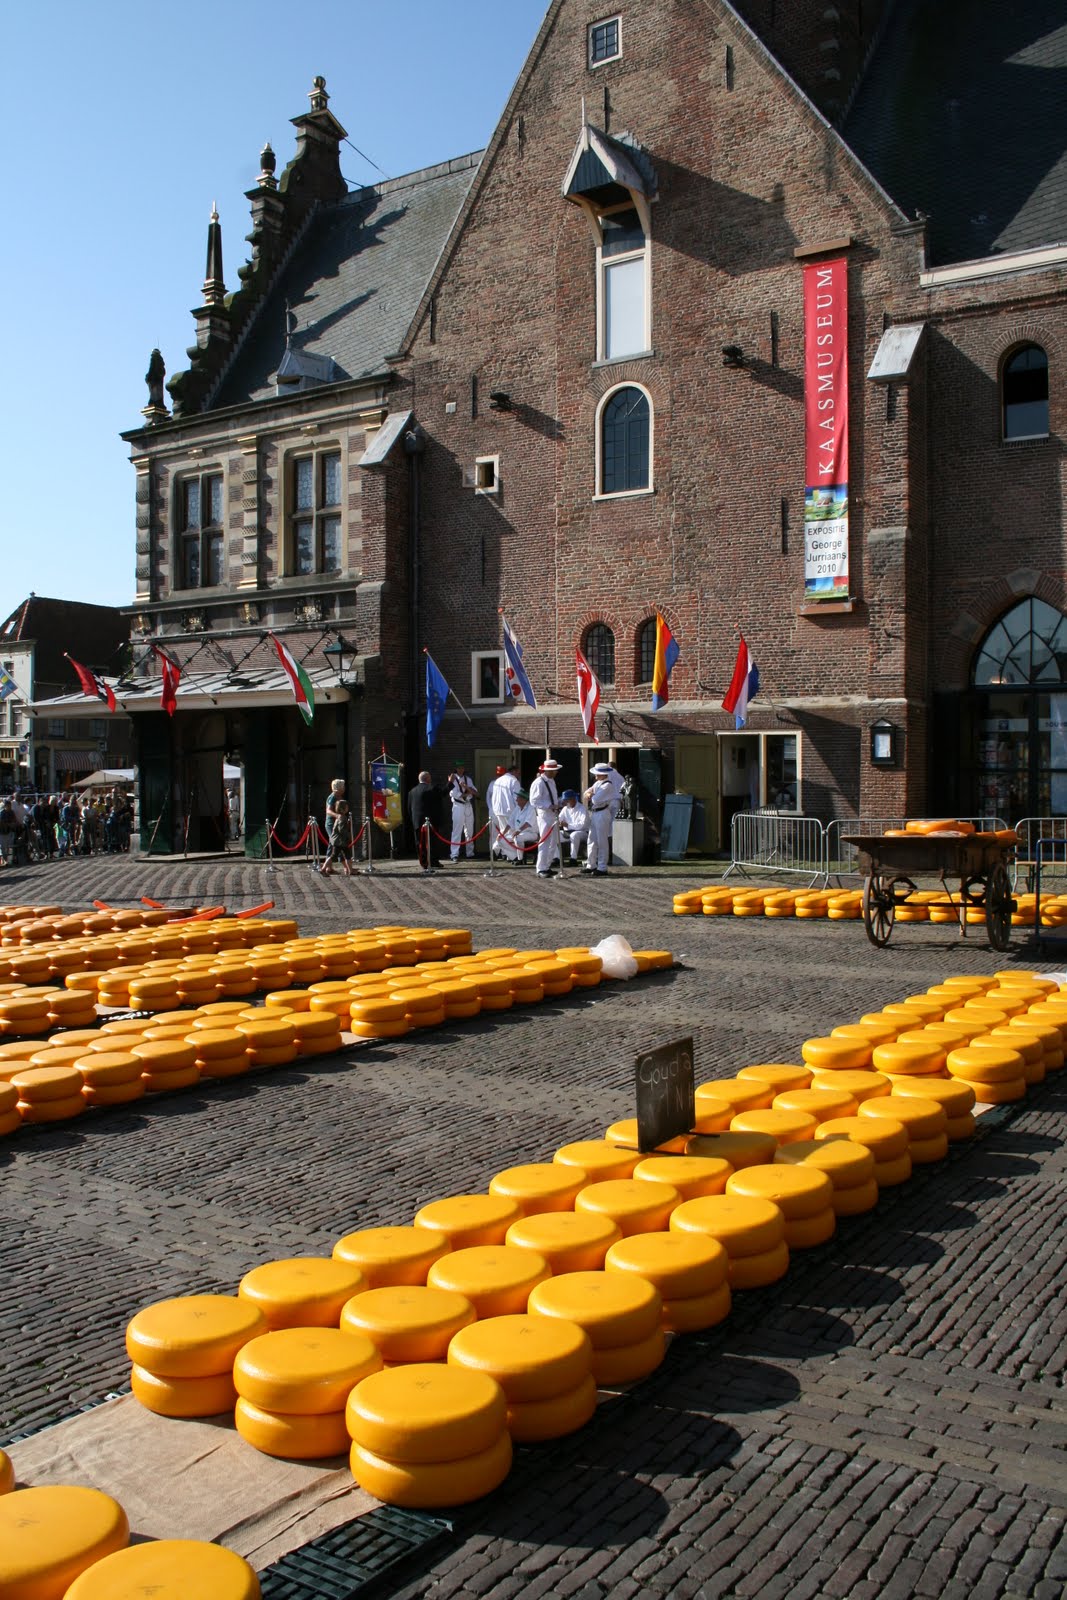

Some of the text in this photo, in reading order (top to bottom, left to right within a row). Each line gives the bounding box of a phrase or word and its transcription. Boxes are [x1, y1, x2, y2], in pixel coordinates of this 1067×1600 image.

[816, 267, 834, 475] KAASMUSEUM
[807, 525, 845, 536] EXPOSITIE
[811, 540, 842, 550] George
[806, 552, 847, 562] Jurriaans
[817, 563, 837, 574] 2010
[640, 1050, 692, 1092] Gouda
